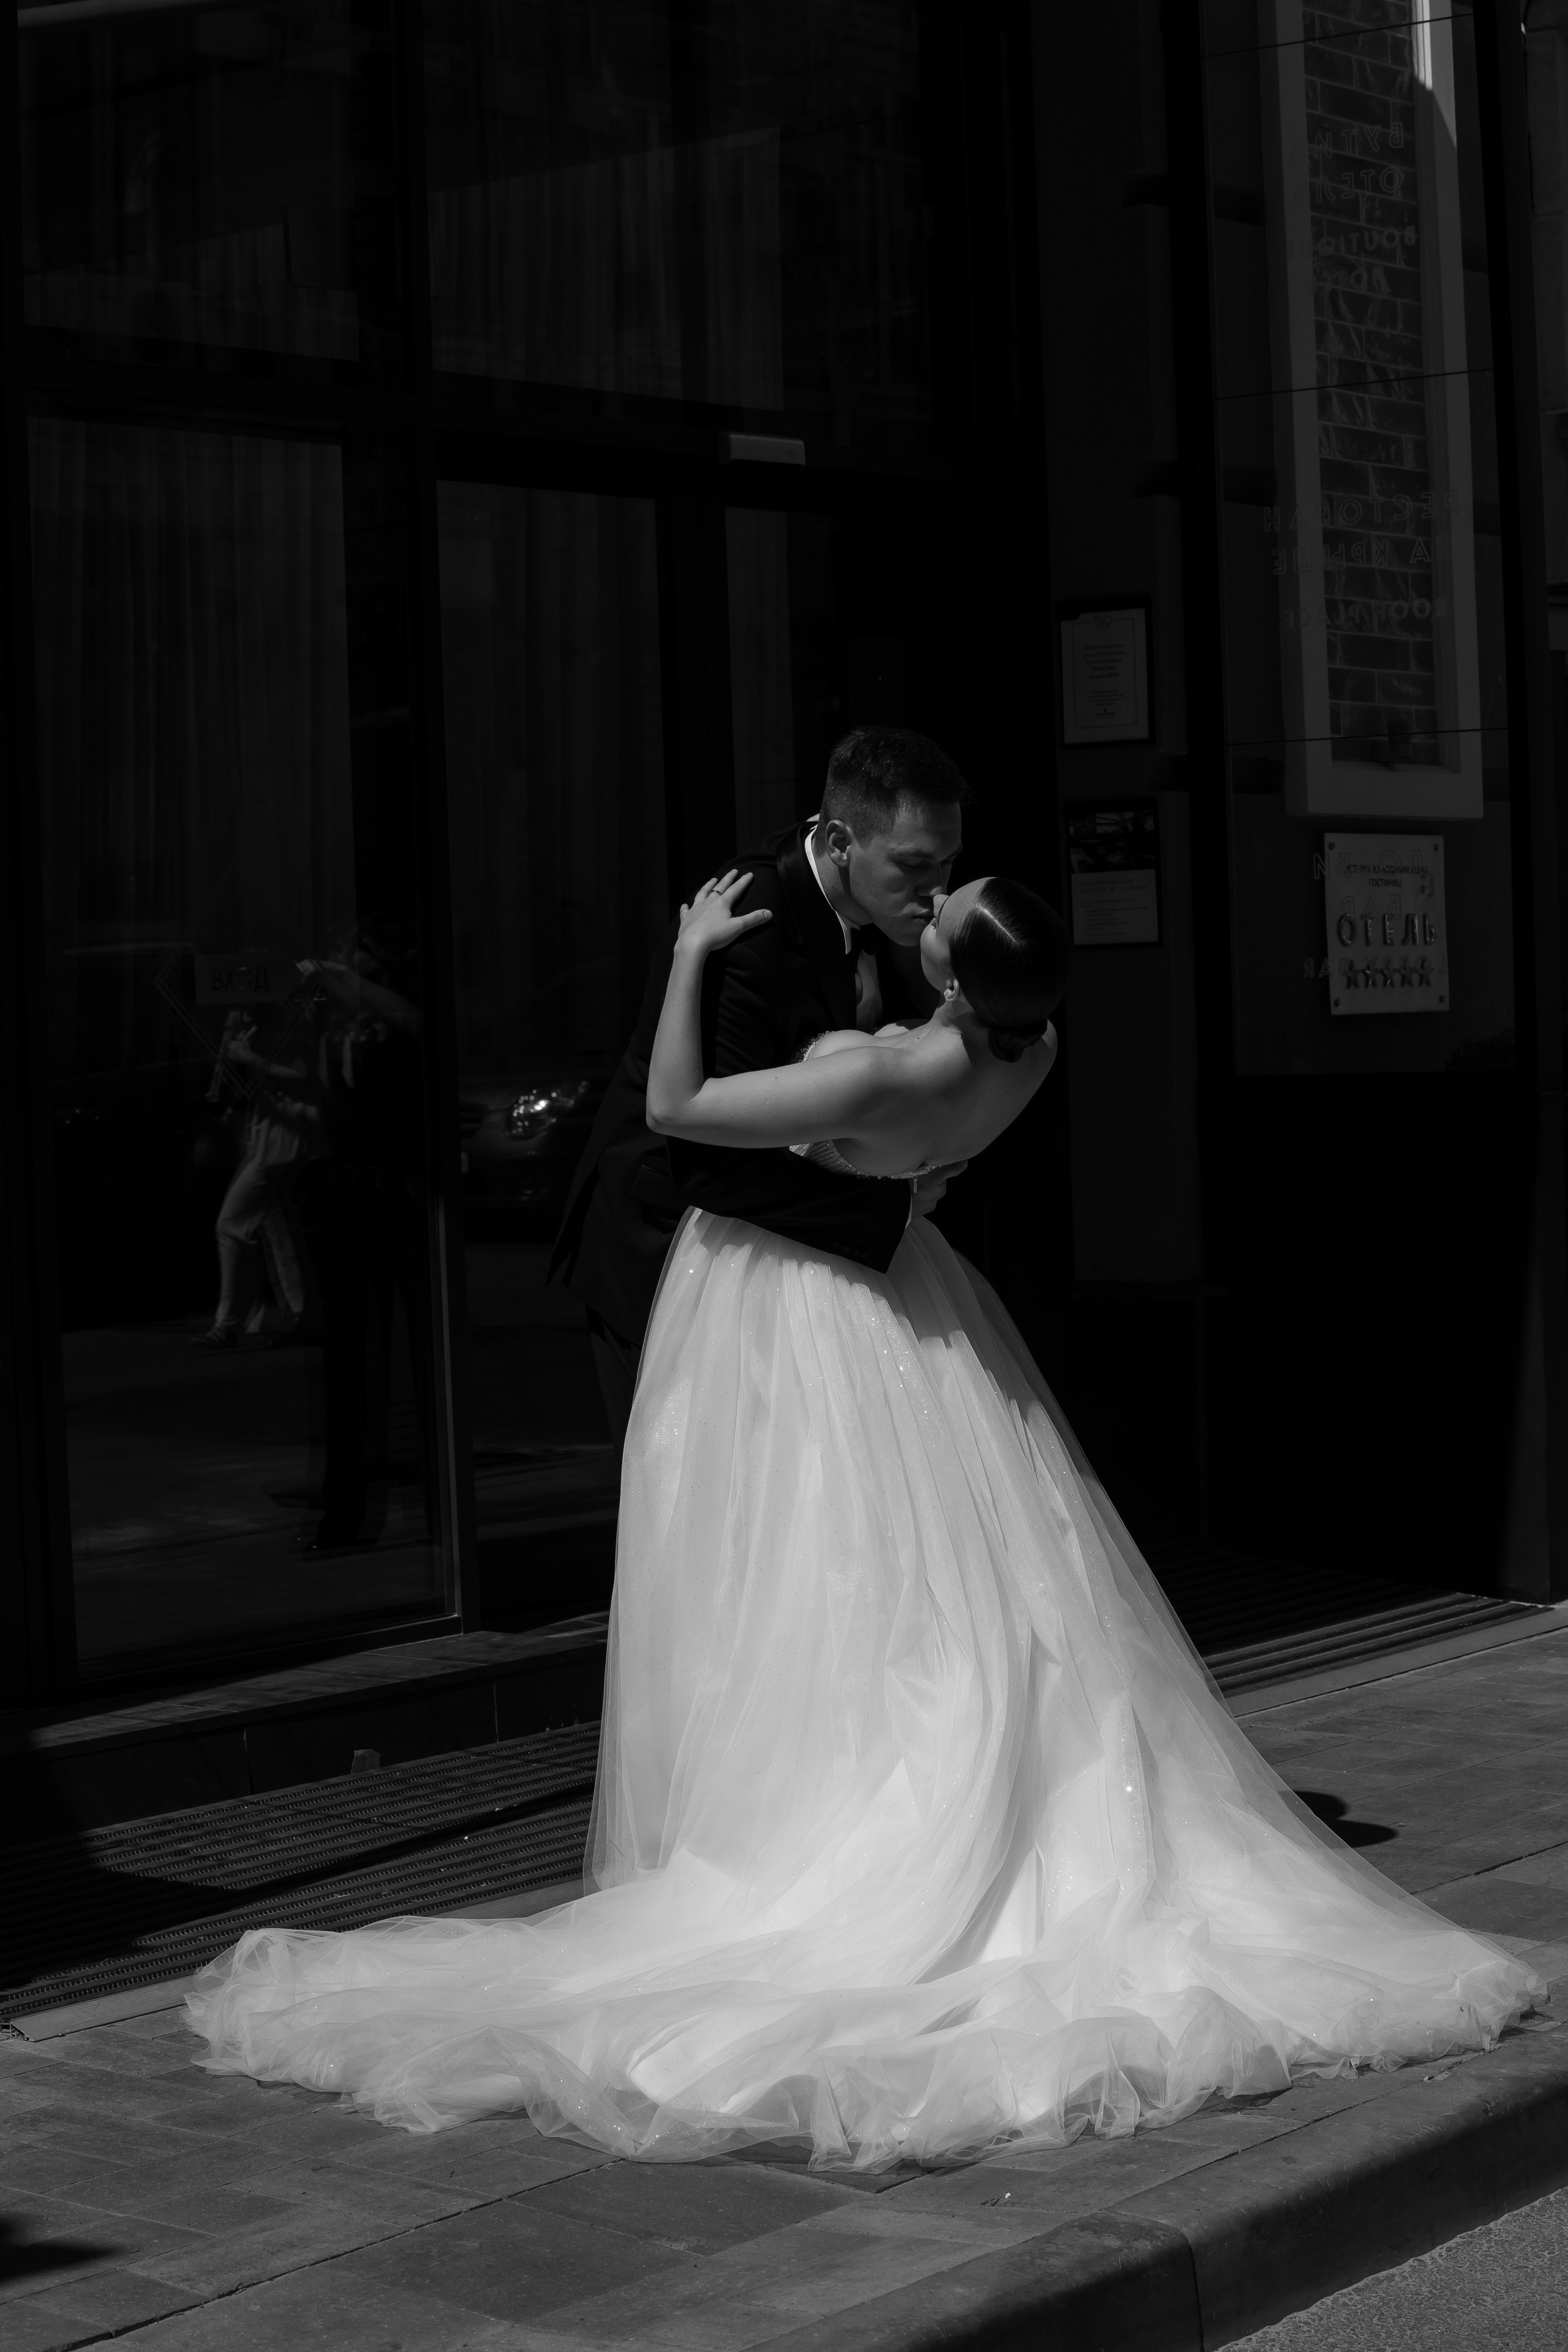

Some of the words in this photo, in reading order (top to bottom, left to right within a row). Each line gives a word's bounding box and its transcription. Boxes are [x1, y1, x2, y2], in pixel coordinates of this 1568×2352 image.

[1368, 878, 1401, 888] ГОСТИНИЦ
[1337, 913, 1436, 947] ОТЕЛЬ
[212, 965, 270, 993] ВХОД
